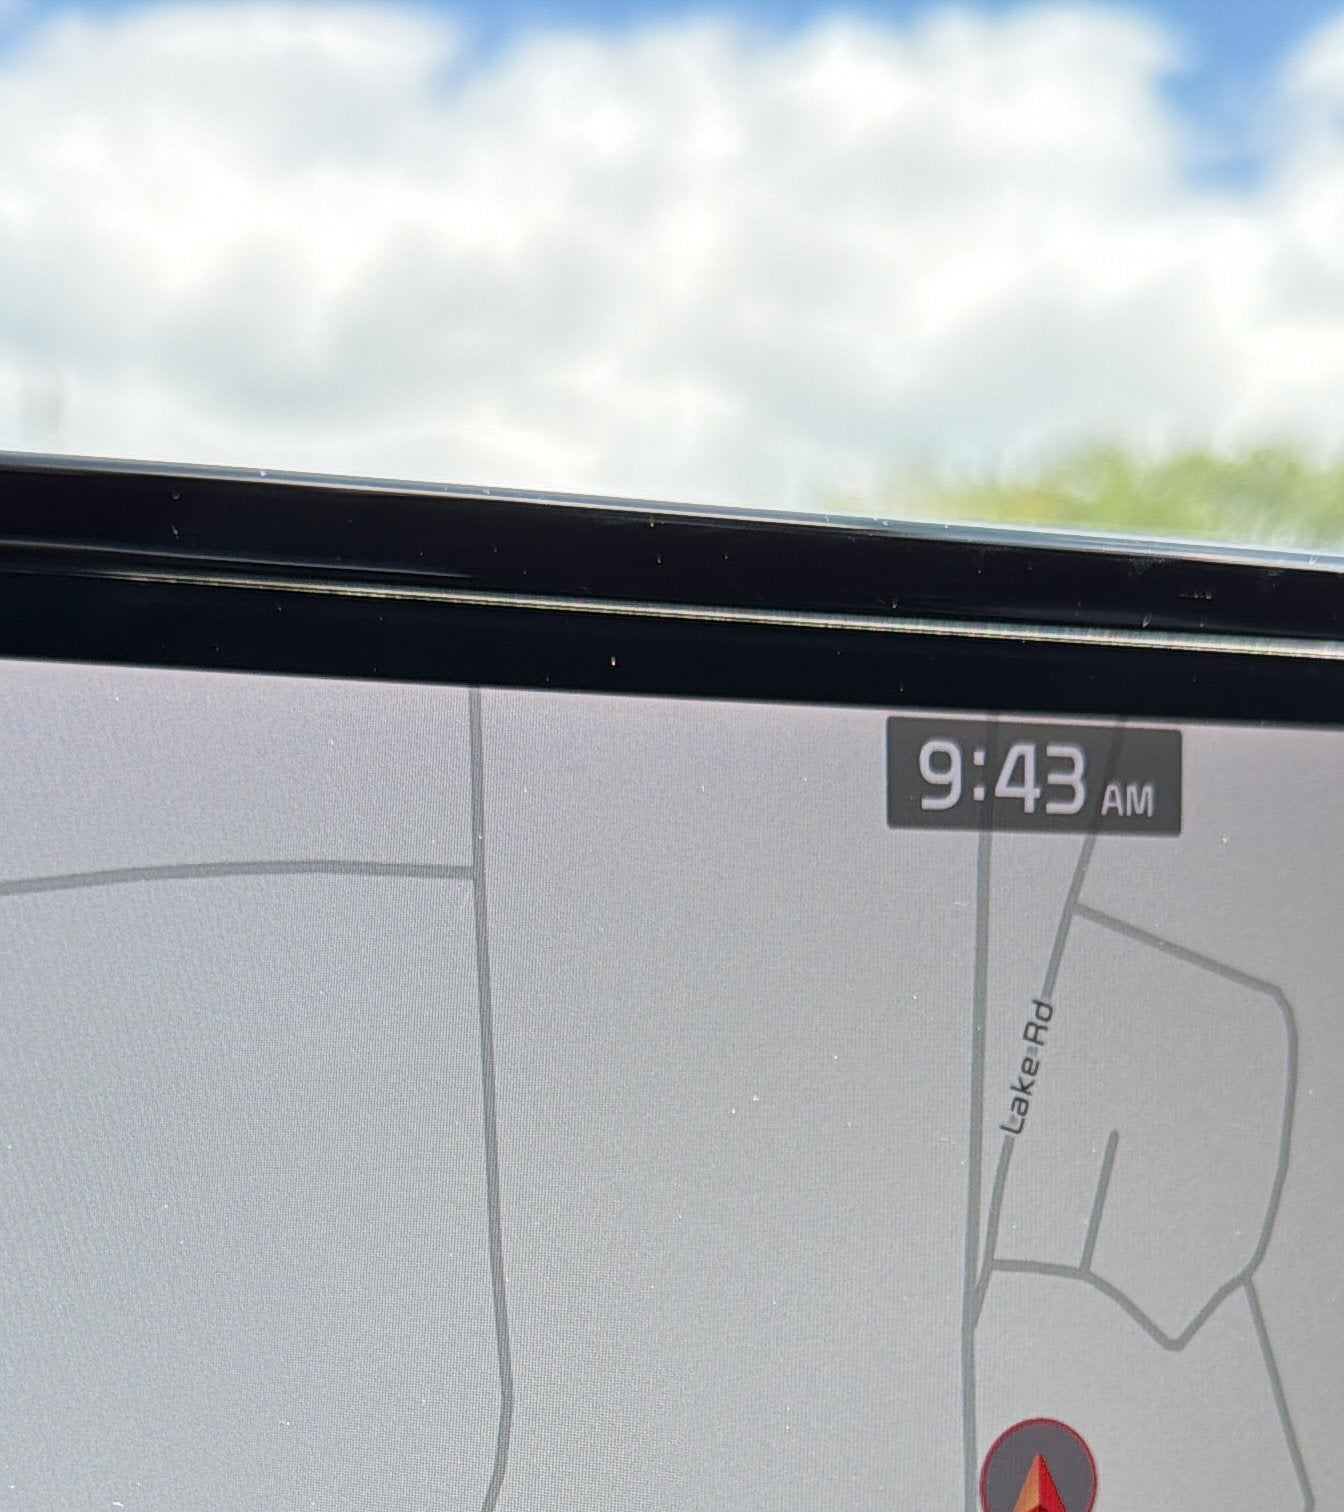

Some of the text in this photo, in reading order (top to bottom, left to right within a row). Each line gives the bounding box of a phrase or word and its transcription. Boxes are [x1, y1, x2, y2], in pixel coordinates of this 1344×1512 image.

[918, 739, 1155, 818] 9:43 AM
[1000, 999, 1054, 1137] Lake Rd
